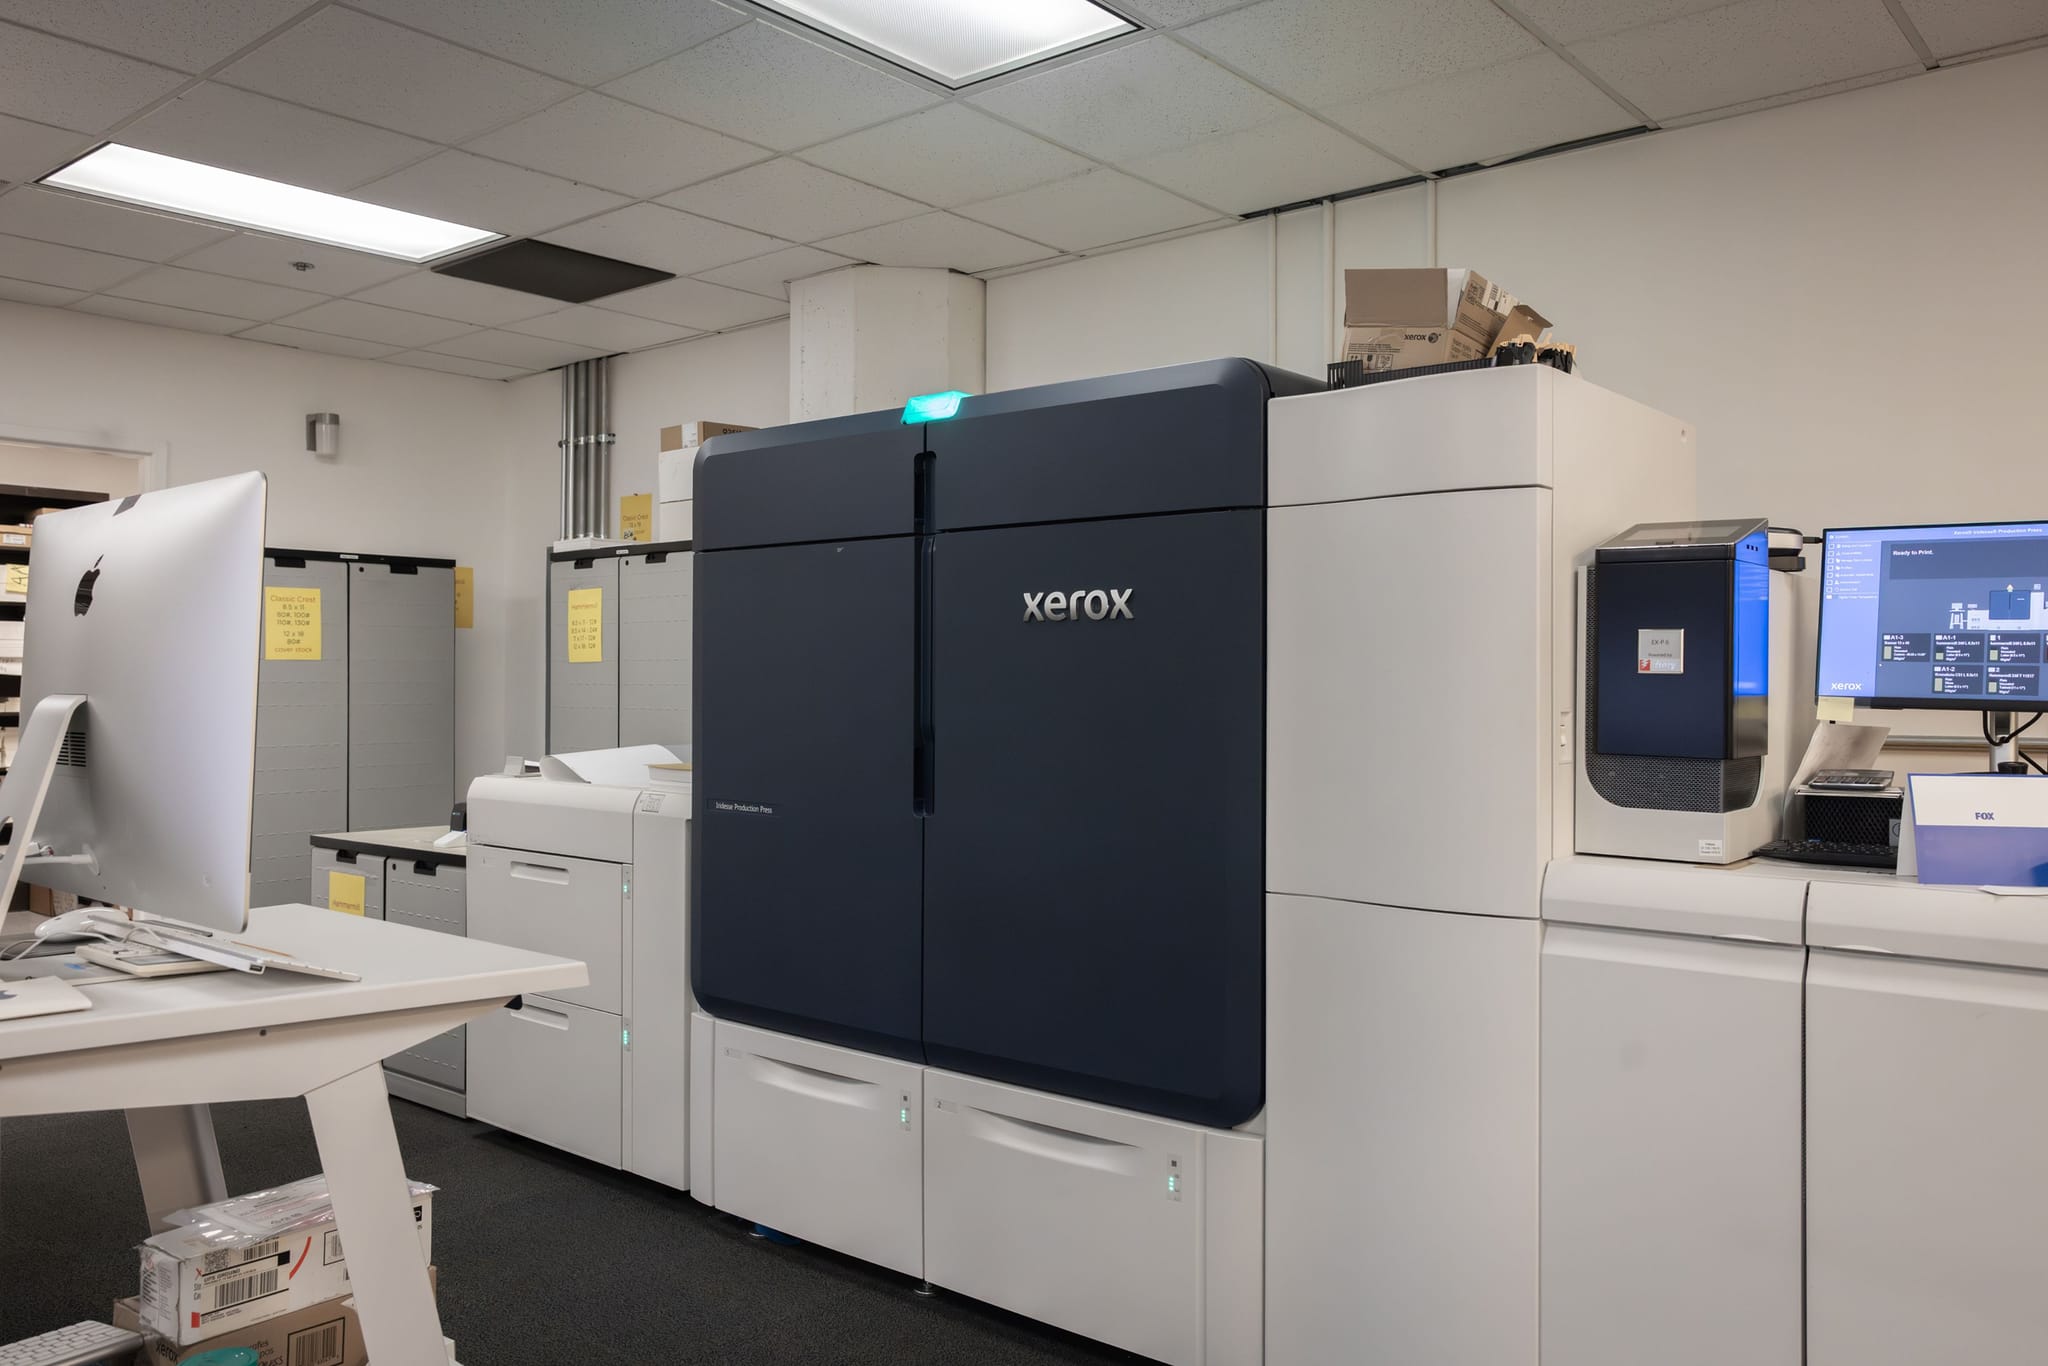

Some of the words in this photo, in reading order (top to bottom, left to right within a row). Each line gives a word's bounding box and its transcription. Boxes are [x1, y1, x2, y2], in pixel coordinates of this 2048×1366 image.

[1023, 588, 1134, 622] xerox
[734, 803, 759, 812] Production
[760, 806, 772, 814] Press
[1975, 812, 1994, 820] FOX
